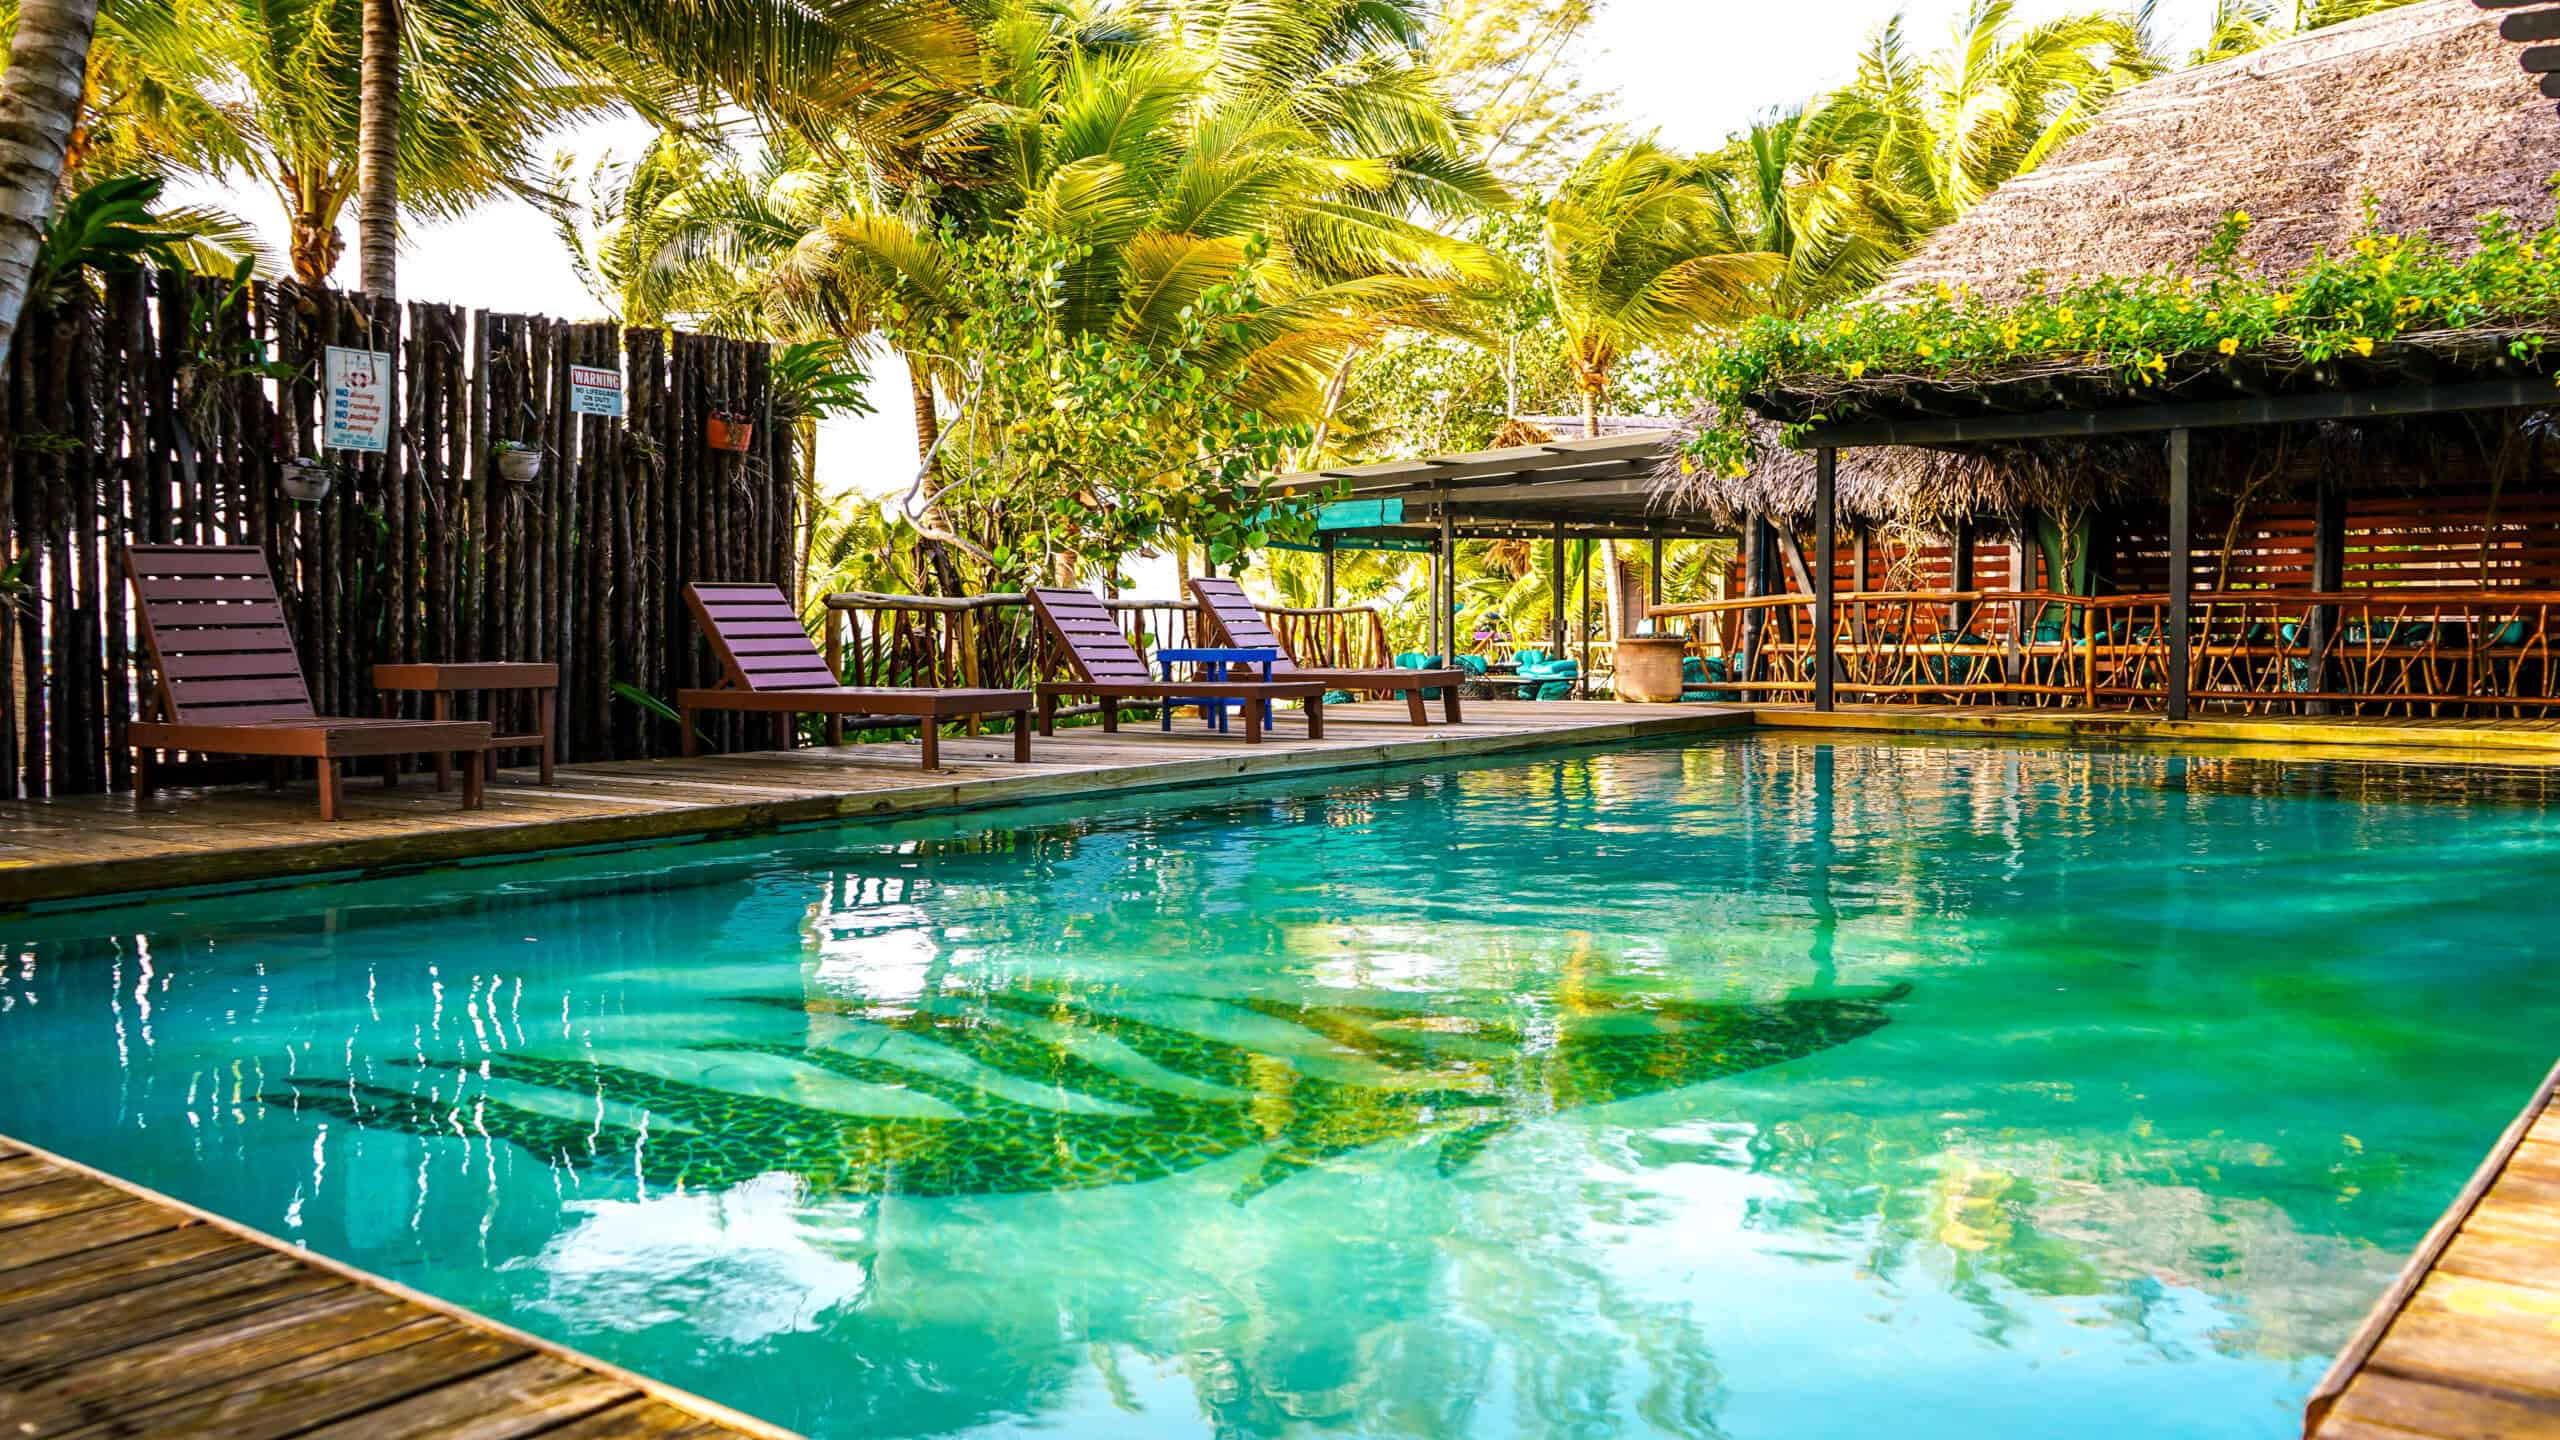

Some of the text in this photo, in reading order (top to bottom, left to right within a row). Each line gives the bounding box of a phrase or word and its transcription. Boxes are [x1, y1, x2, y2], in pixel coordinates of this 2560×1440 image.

[574, 370, 619, 388] WARNING
[336, 388, 348, 397] NO
[336, 400, 348, 408] NO
[335, 410, 347, 419] NO
[335, 421, 347, 430] NO
